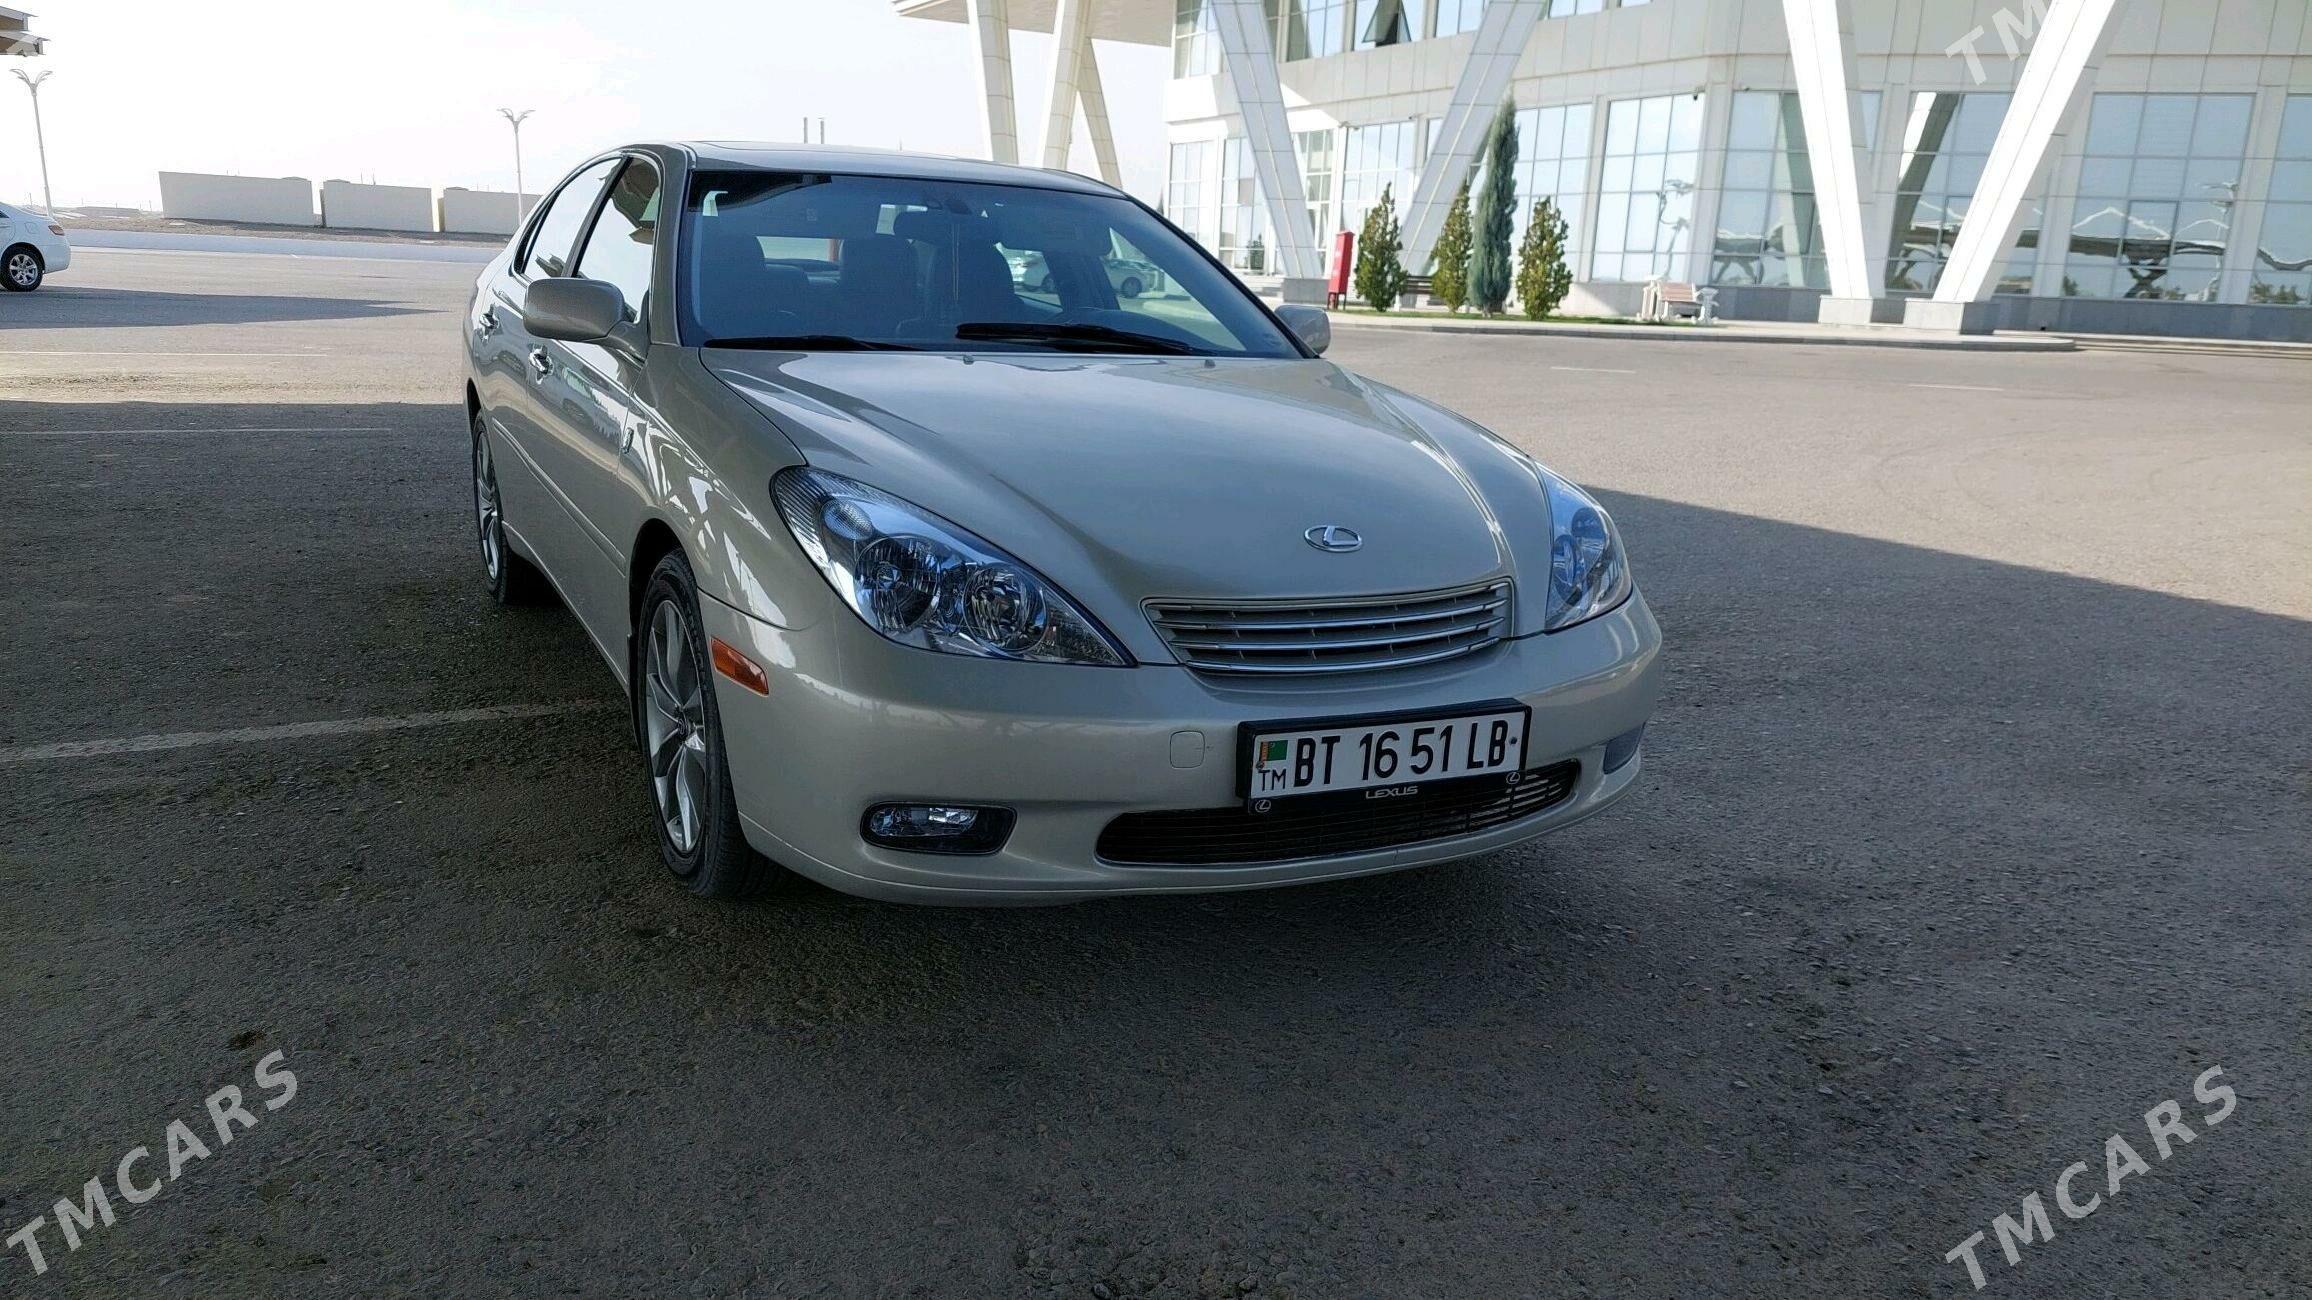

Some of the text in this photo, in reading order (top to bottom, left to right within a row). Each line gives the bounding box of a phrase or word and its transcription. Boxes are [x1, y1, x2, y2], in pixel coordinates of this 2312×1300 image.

[1294, 736, 1341, 787] BT
[1467, 720, 1508, 769] LB
[1258, 768, 1287, 791] TM
[1365, 785, 1419, 799] LEXUS
